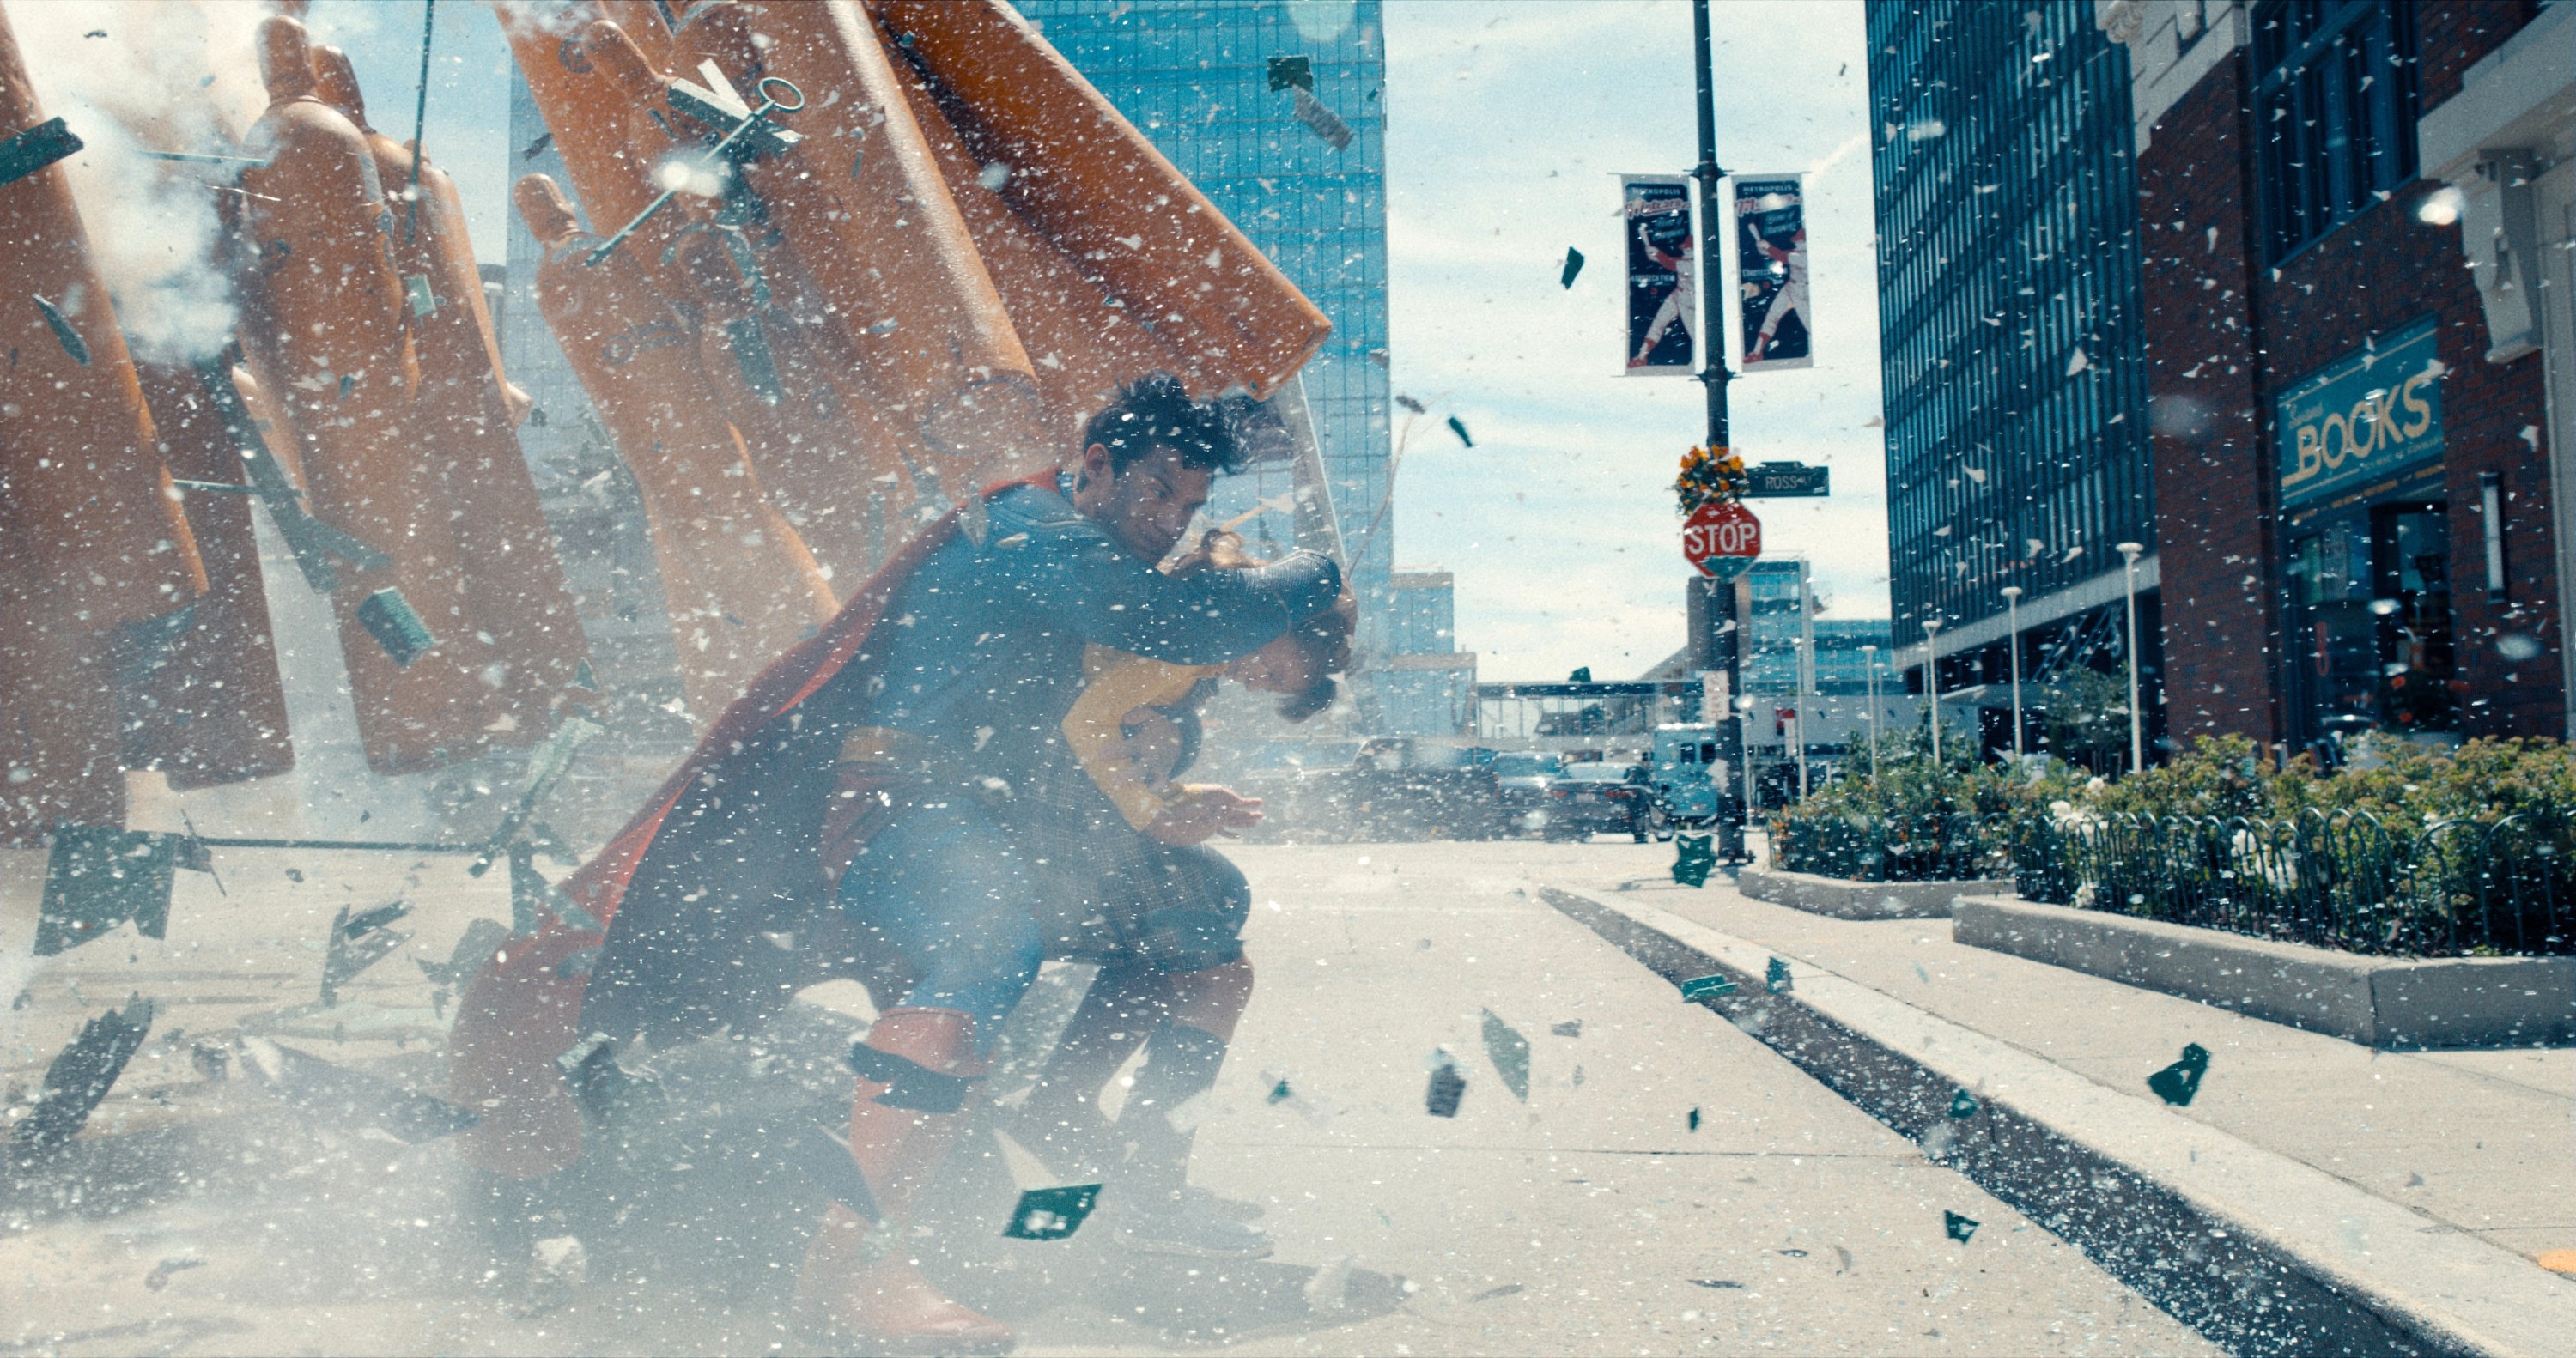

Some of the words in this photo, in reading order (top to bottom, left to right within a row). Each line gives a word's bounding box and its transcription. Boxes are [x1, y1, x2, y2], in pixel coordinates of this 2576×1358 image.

[2281, 369, 2440, 487] BOOKS
[1765, 476, 1798, 489] ROSS
[1688, 524, 1756, 555] STOP
